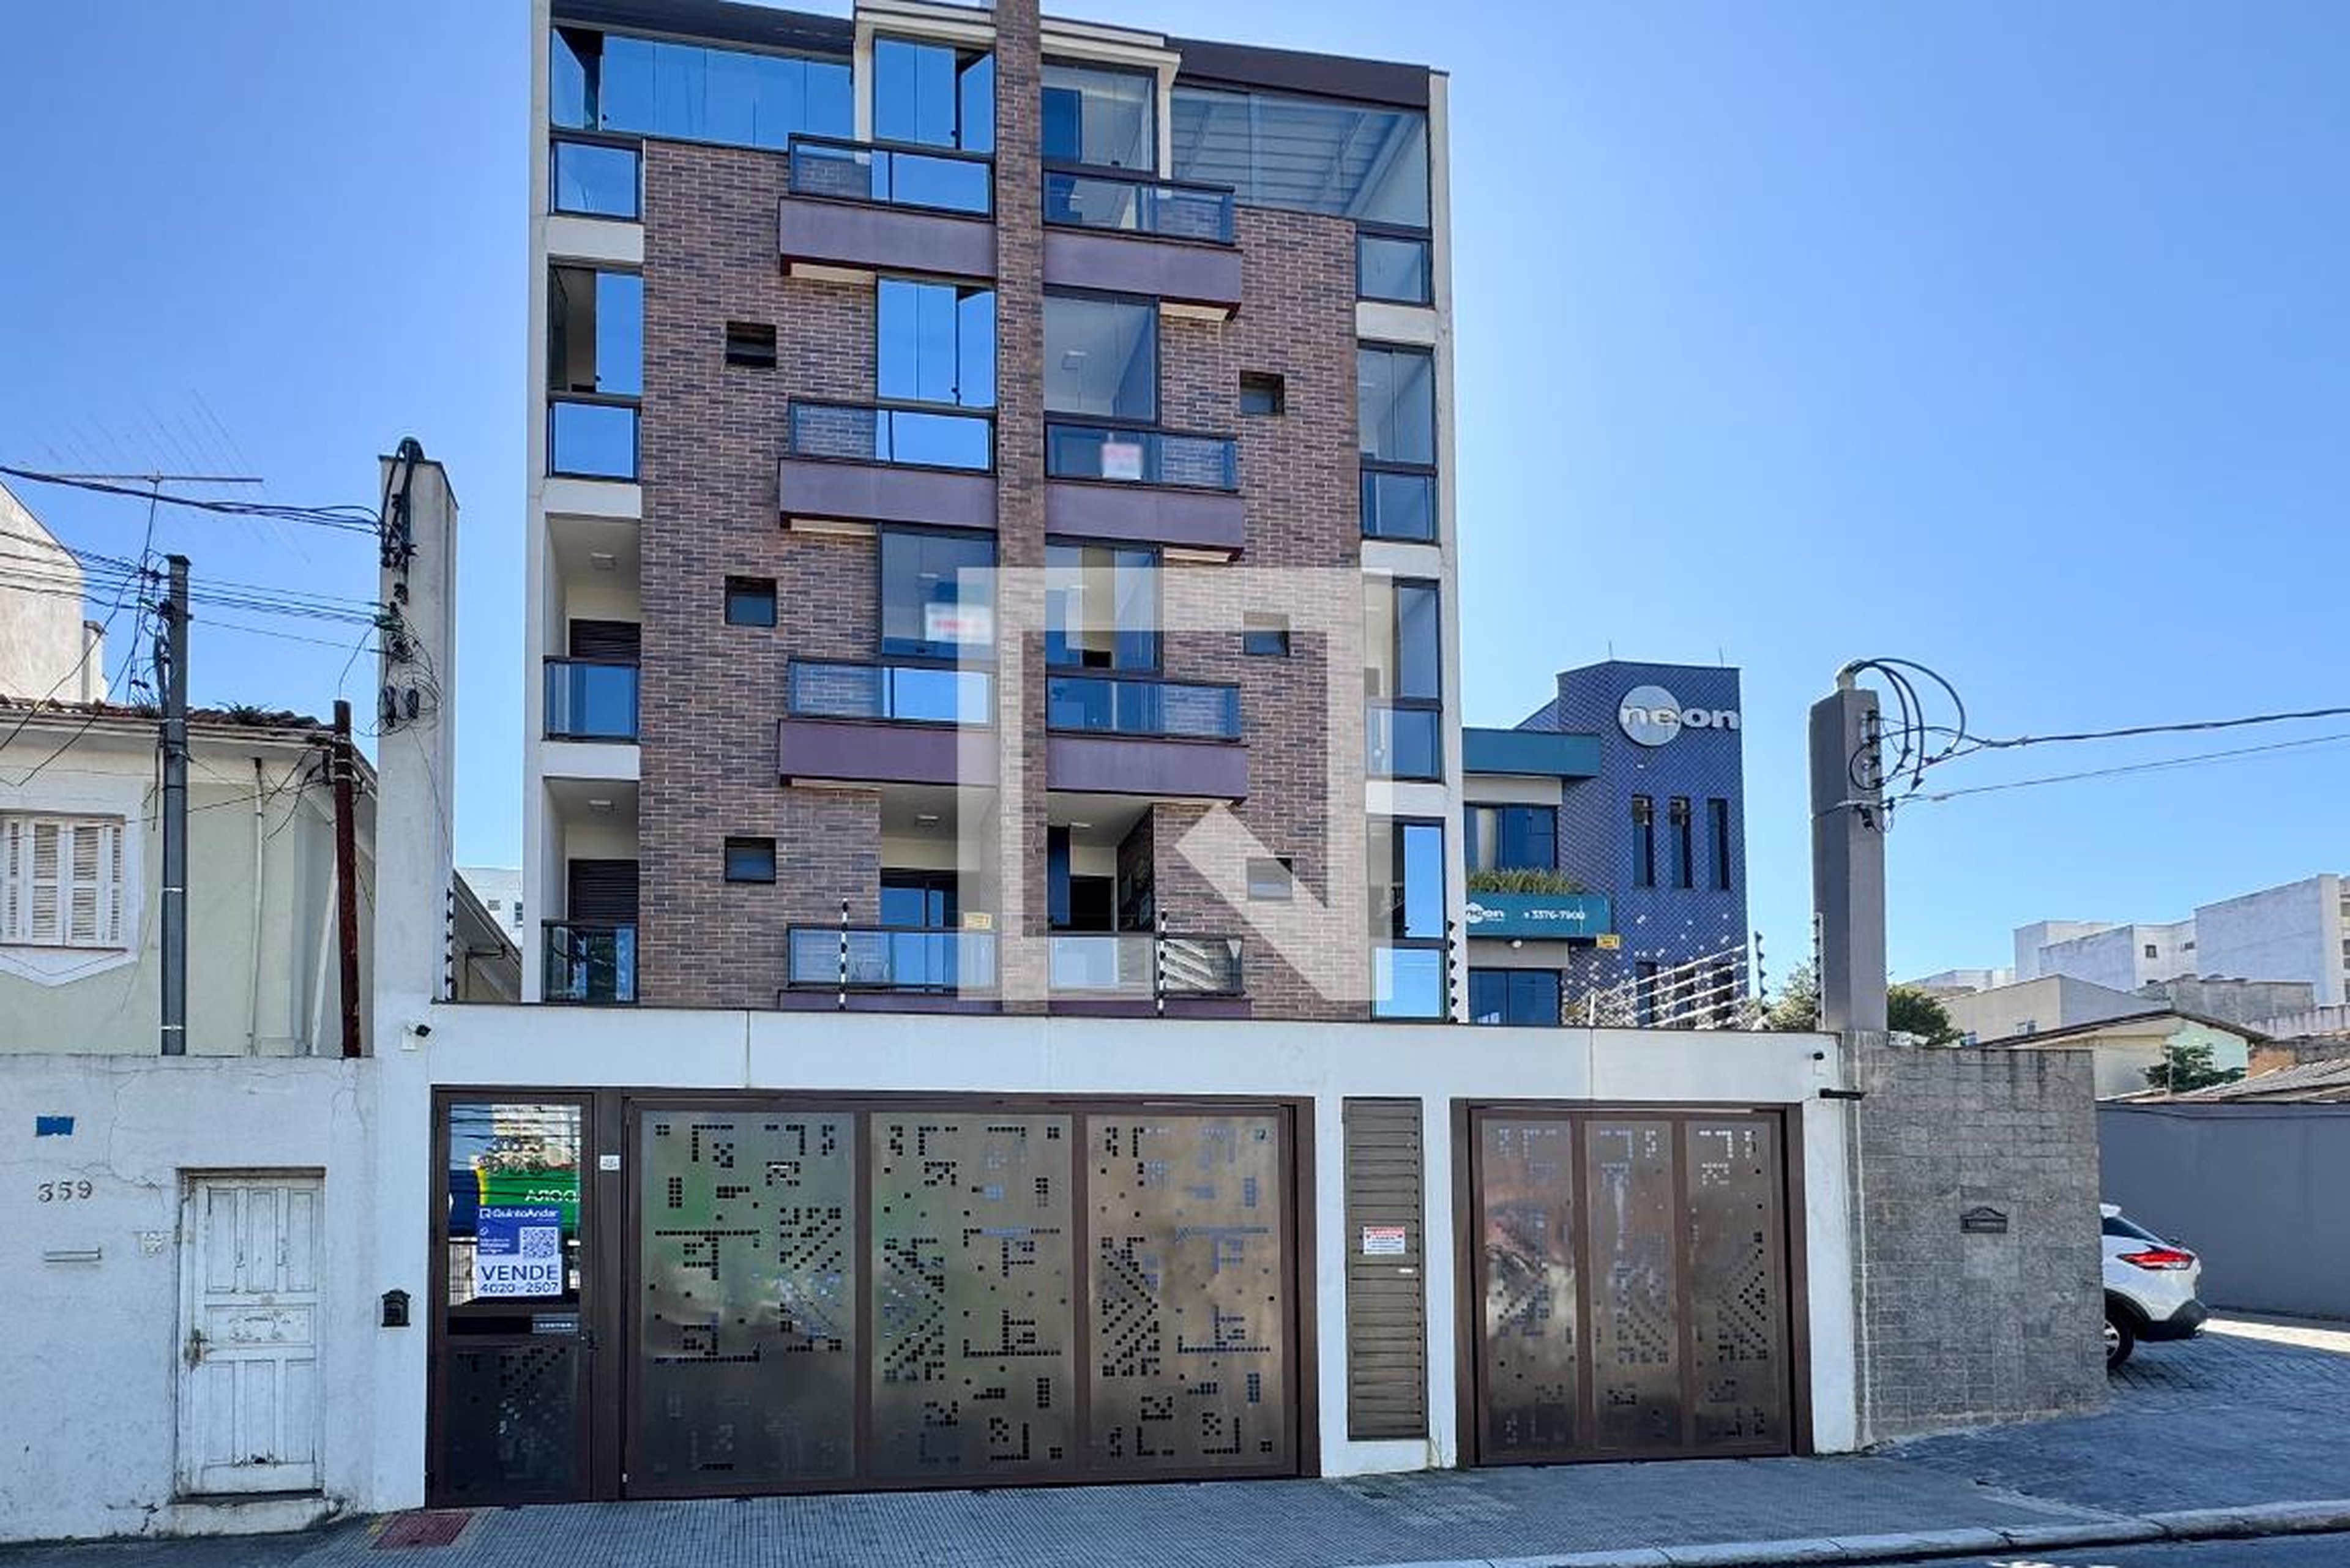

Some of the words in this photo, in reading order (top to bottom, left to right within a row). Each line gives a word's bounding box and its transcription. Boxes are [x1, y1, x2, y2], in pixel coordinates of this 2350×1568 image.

[1622, 706, 1740, 729] neon
[38, 1179, 92, 1203] 359
[492, 1208, 559, 1218] QuintoAndar
[481, 1265, 558, 1280] VENDE
